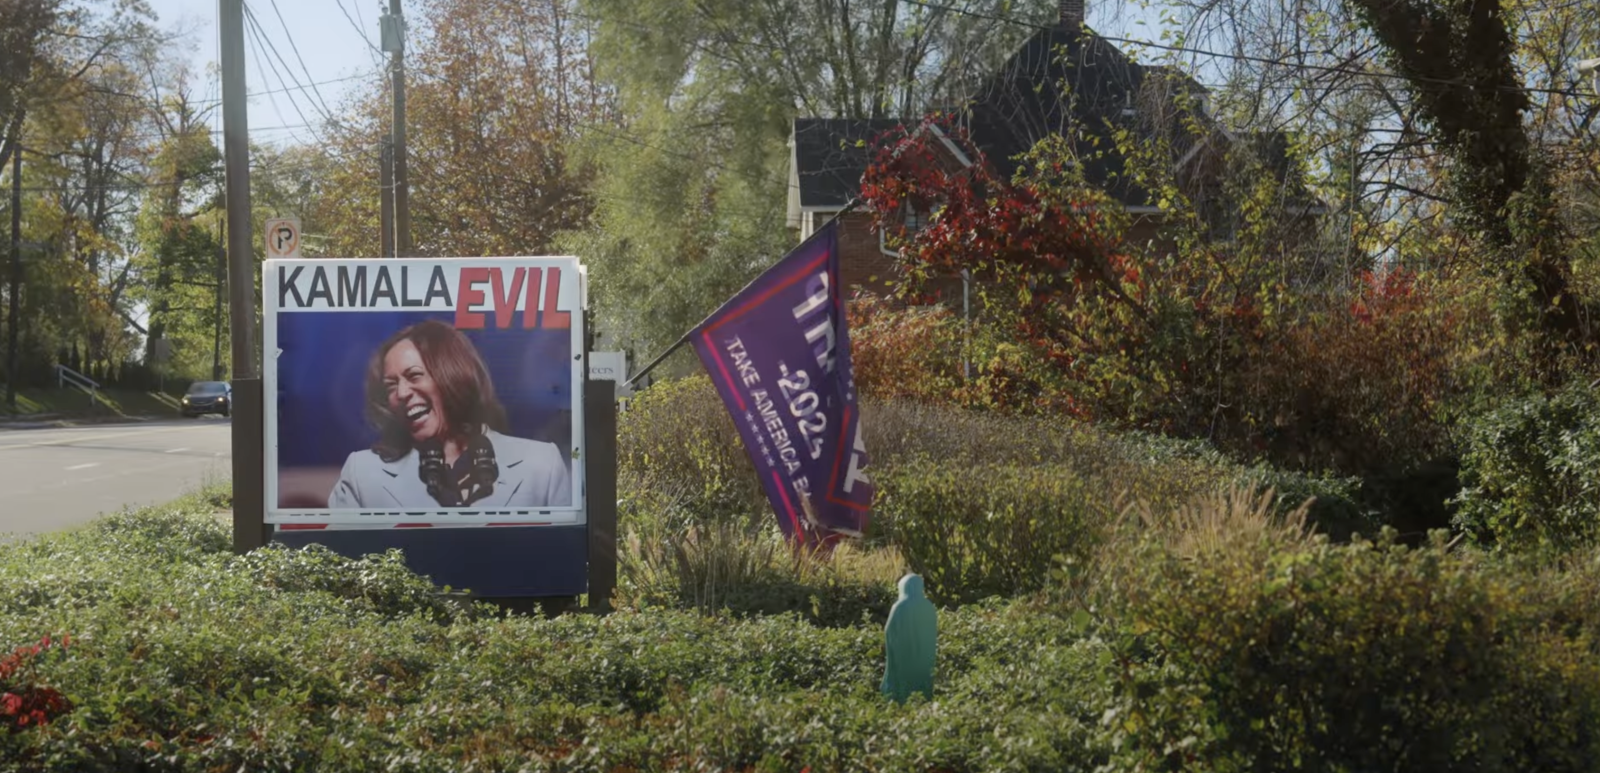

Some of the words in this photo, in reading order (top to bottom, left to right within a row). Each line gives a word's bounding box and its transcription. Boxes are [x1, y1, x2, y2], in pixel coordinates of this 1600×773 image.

[278, 265, 453, 308] KAMALA
[454, 266, 572, 330] EVIL
[588, 366, 614, 375] eers
[724, 334, 760, 388] TAKE
[751, 387, 804, 480] AMERICA
